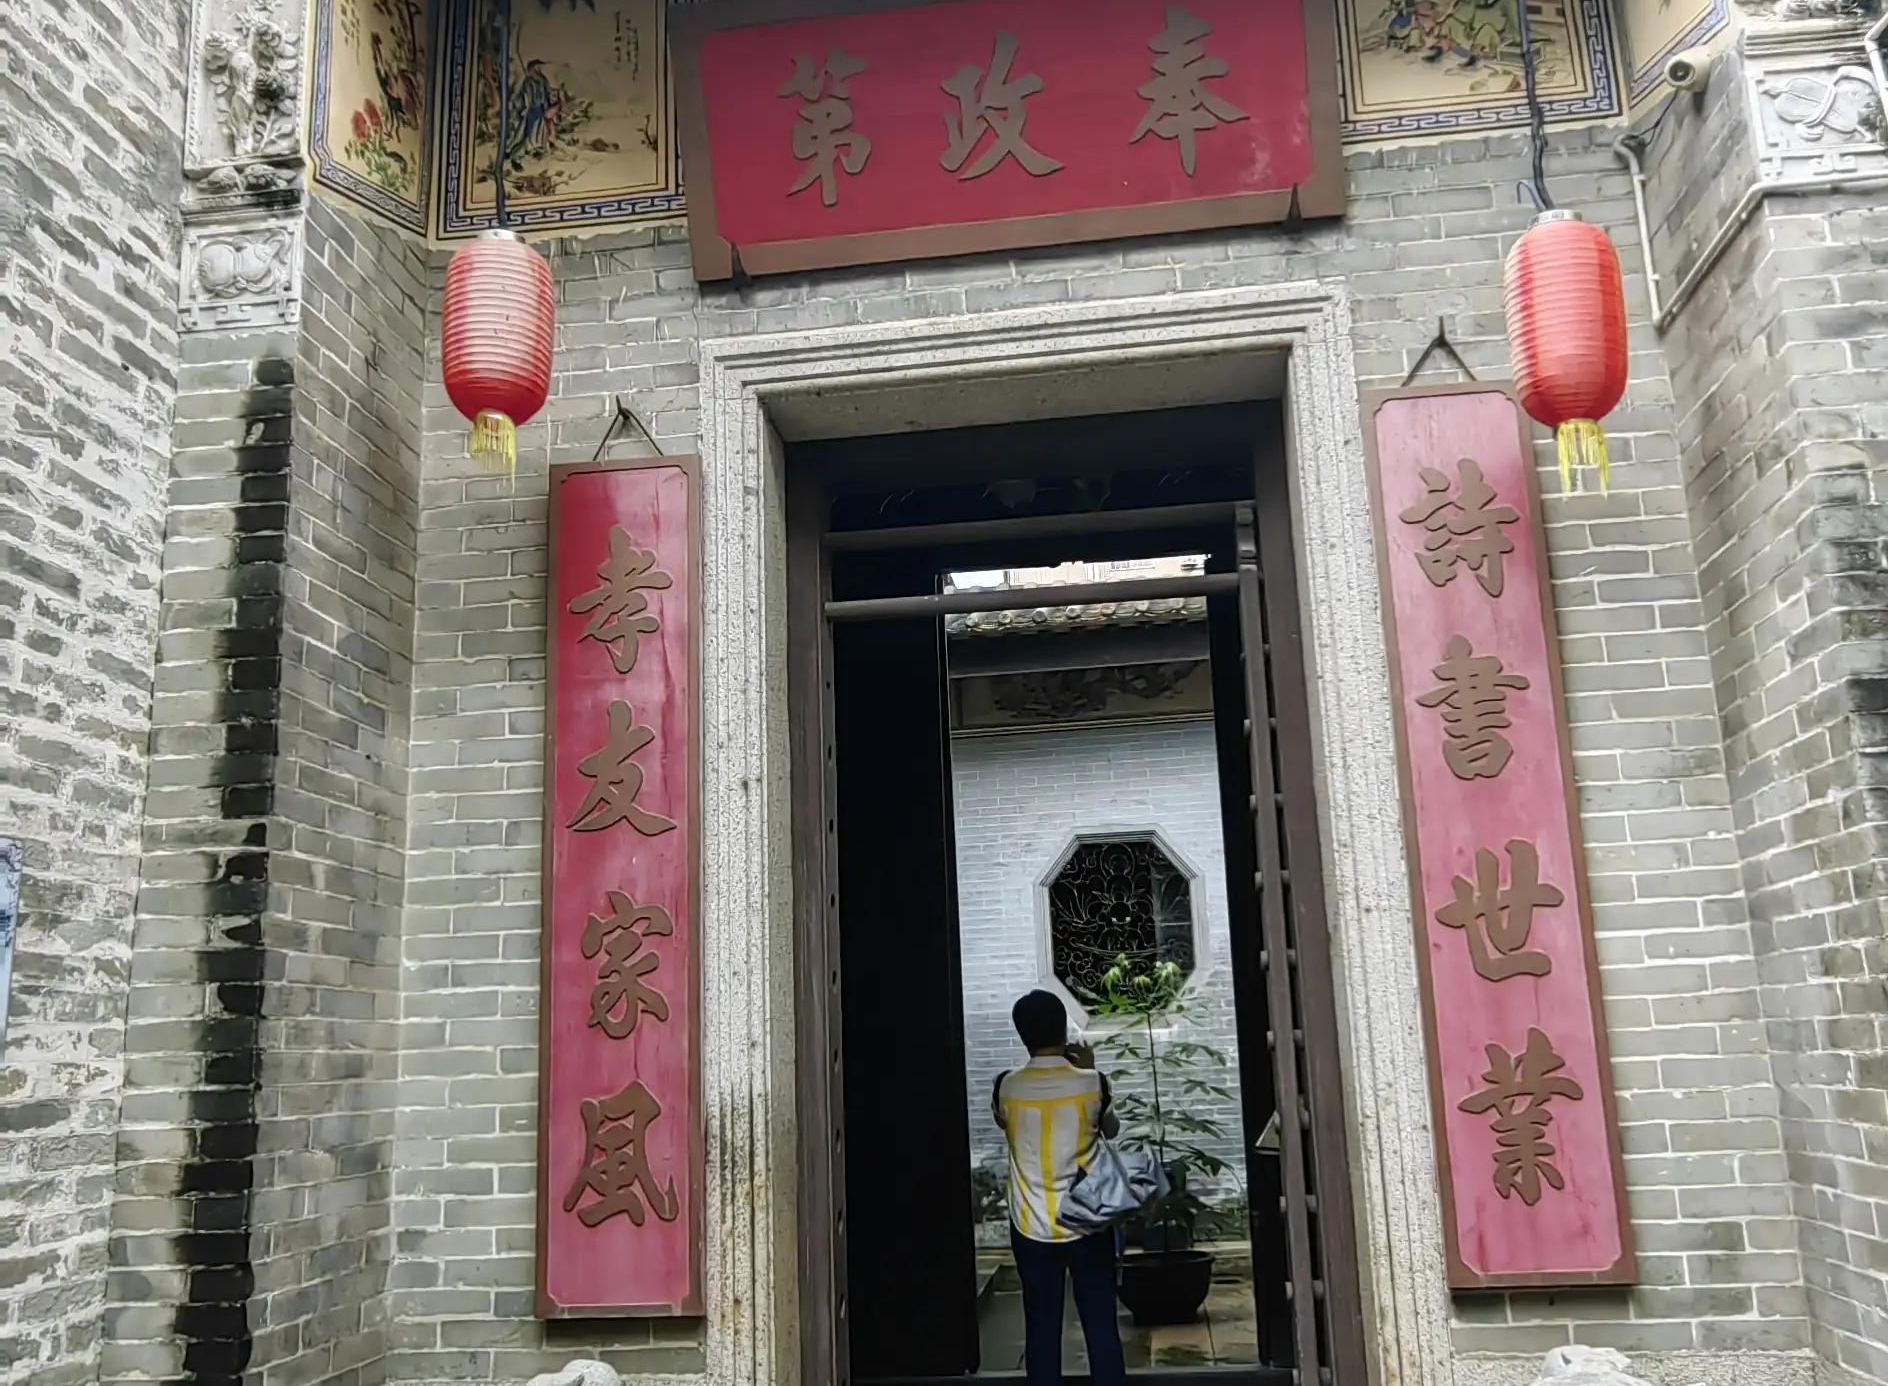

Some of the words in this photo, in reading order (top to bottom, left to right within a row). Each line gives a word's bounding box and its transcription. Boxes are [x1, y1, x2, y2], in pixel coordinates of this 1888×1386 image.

[564, 527, 679, 1228] 孝友家風
[1400, 457, 1583, 1207] 詩書世業
